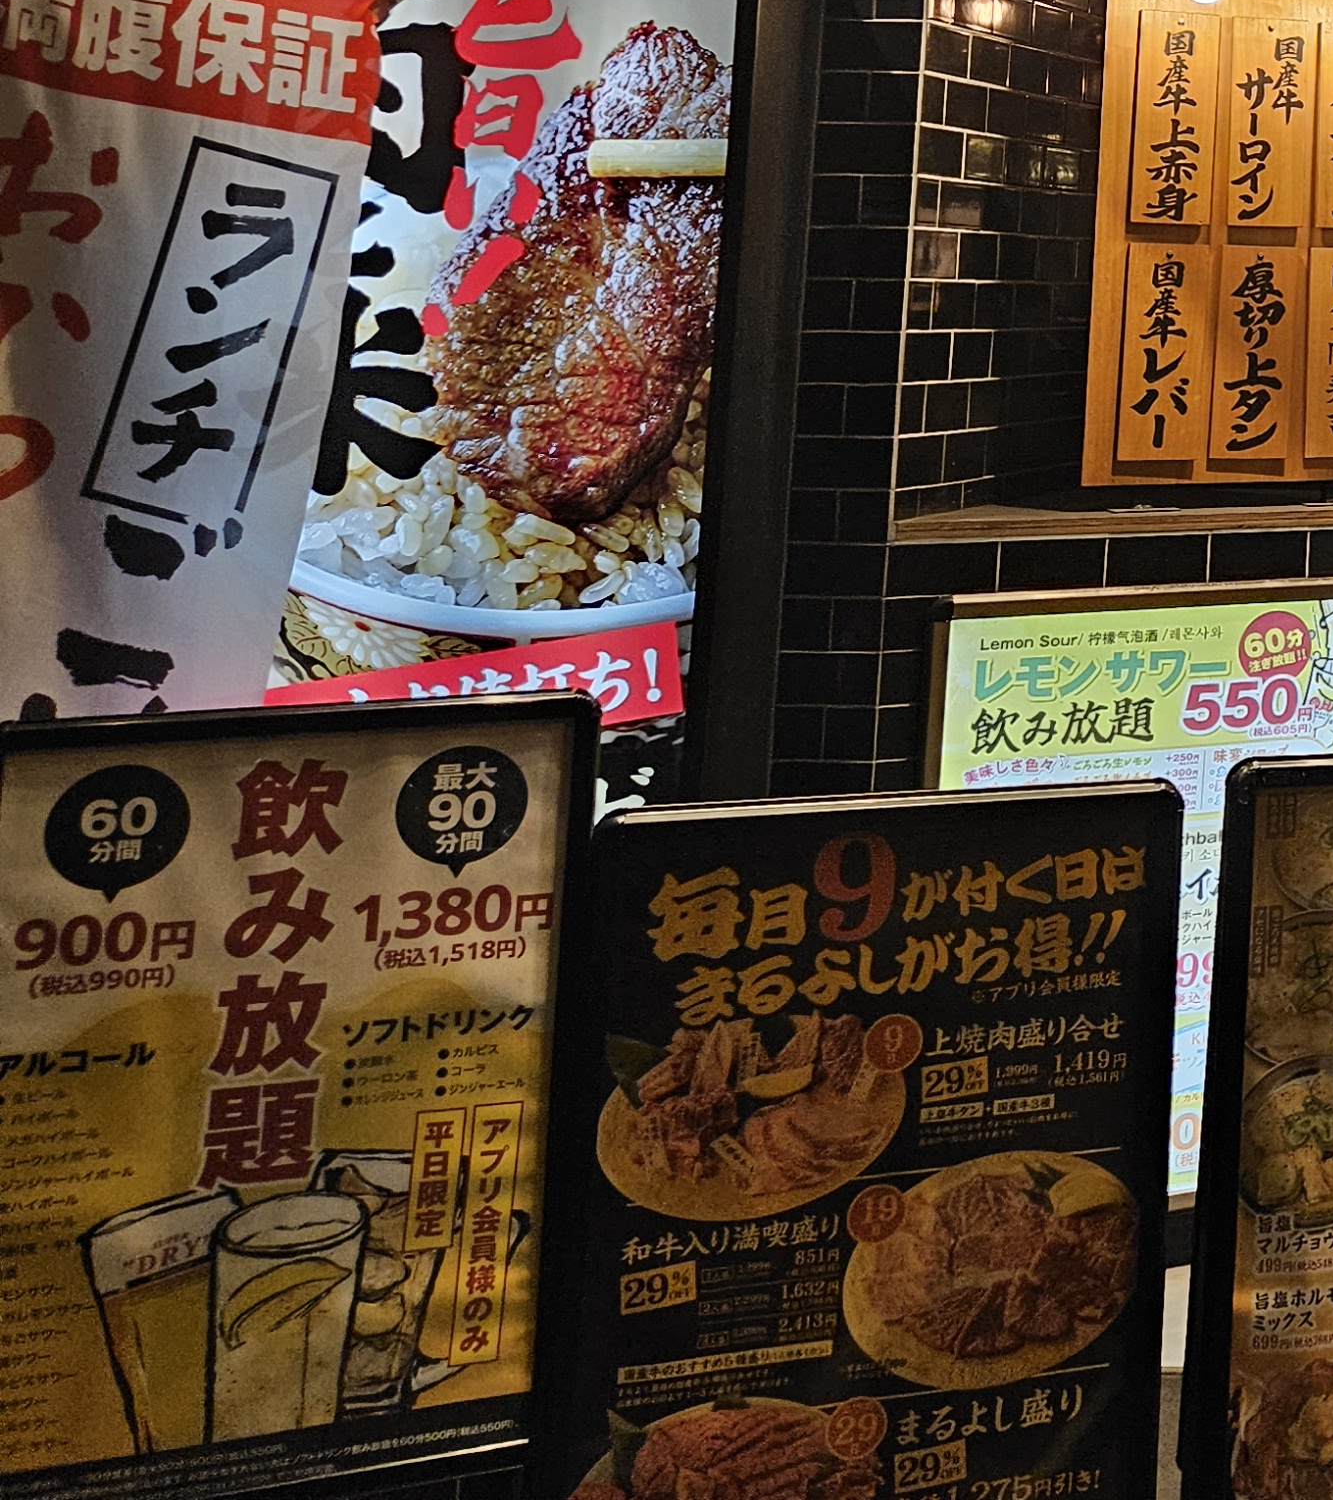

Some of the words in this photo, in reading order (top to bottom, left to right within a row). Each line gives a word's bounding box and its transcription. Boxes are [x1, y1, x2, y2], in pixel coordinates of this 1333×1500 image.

[1229, 69, 1274, 221] サーロイン
[131, 182, 294, 483] ランチ
[1132, 260, 1188, 449] 国産牛レバー
[1223, 261, 1285, 451] 厚切り上タン
[980, 637, 1033, 651] Lemon
[1243, 627, 1303, 658] 60分
[975, 649, 1231, 702] レモンサワー
[971, 698, 1154, 754] 飲み放題
[1249, 723, 1312, 738] (税込605円)
[434, 762, 496, 790] 最大
[80, 795, 157, 840] 60
[428, 792, 496, 832] 90
[90, 837, 141, 863] 分間
[436, 827, 484, 854] 分間
[13, 911, 195, 971] 900円
[354, 884, 554, 949] 1,380円
[199, 758, 349, 1189] 飲み放題
[343, 1005, 535, 1047] ソフトドリンク
[924, 1012, 1124, 1057] 上焼肉盛り合せ
[415, 1121, 455, 1236] 平日限定
[460, 1119, 511, 1353] アプリ会員様のみ
[621, 1214, 840, 1265] 和牛入り満喫盛り
[1252, 1311, 1314, 1331] ミックス
[896, 1385, 1083, 1444] まるよし盛り
